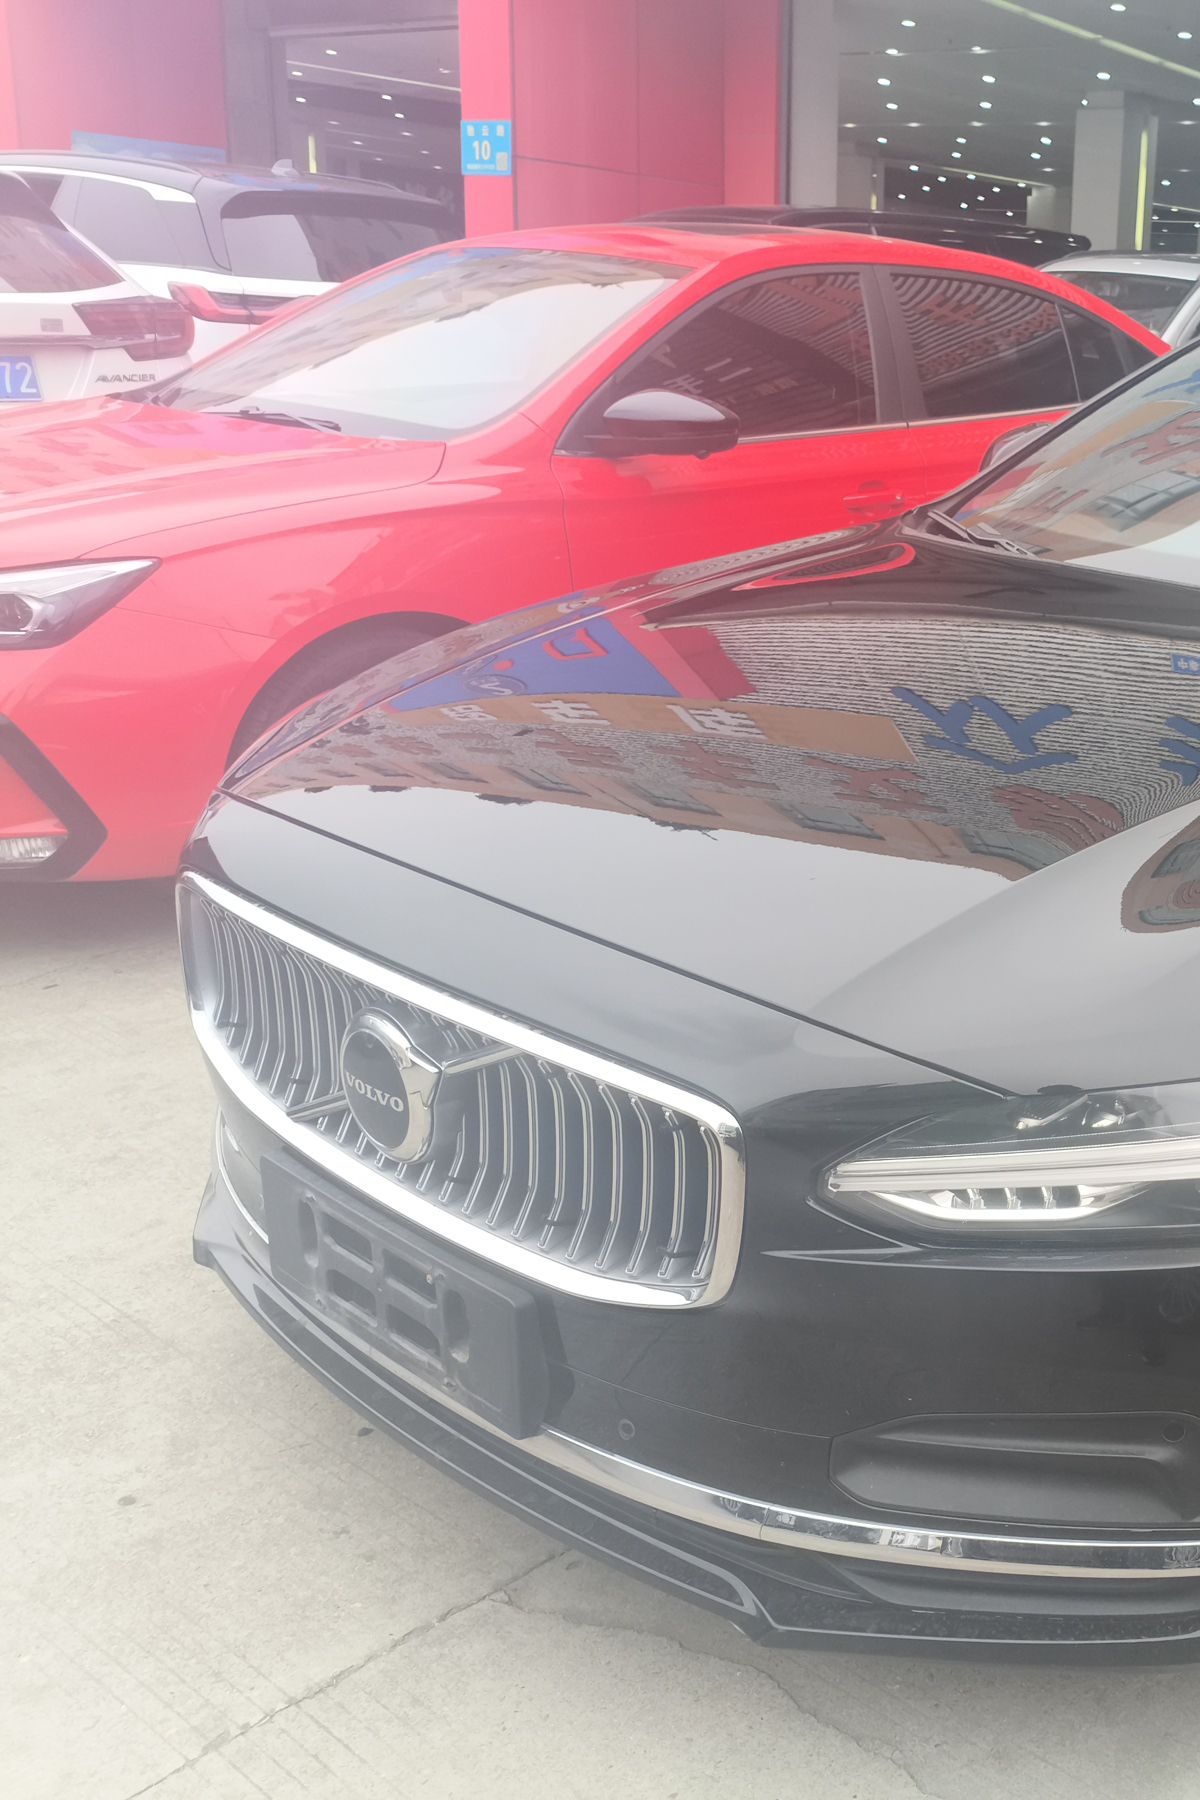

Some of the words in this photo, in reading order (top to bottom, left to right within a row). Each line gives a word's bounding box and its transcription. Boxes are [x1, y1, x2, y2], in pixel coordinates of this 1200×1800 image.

[472, 140, 491, 161] 10
[95, 373, 157, 384] AVANCIER
[345, 1071, 404, 1112] VOLVO
